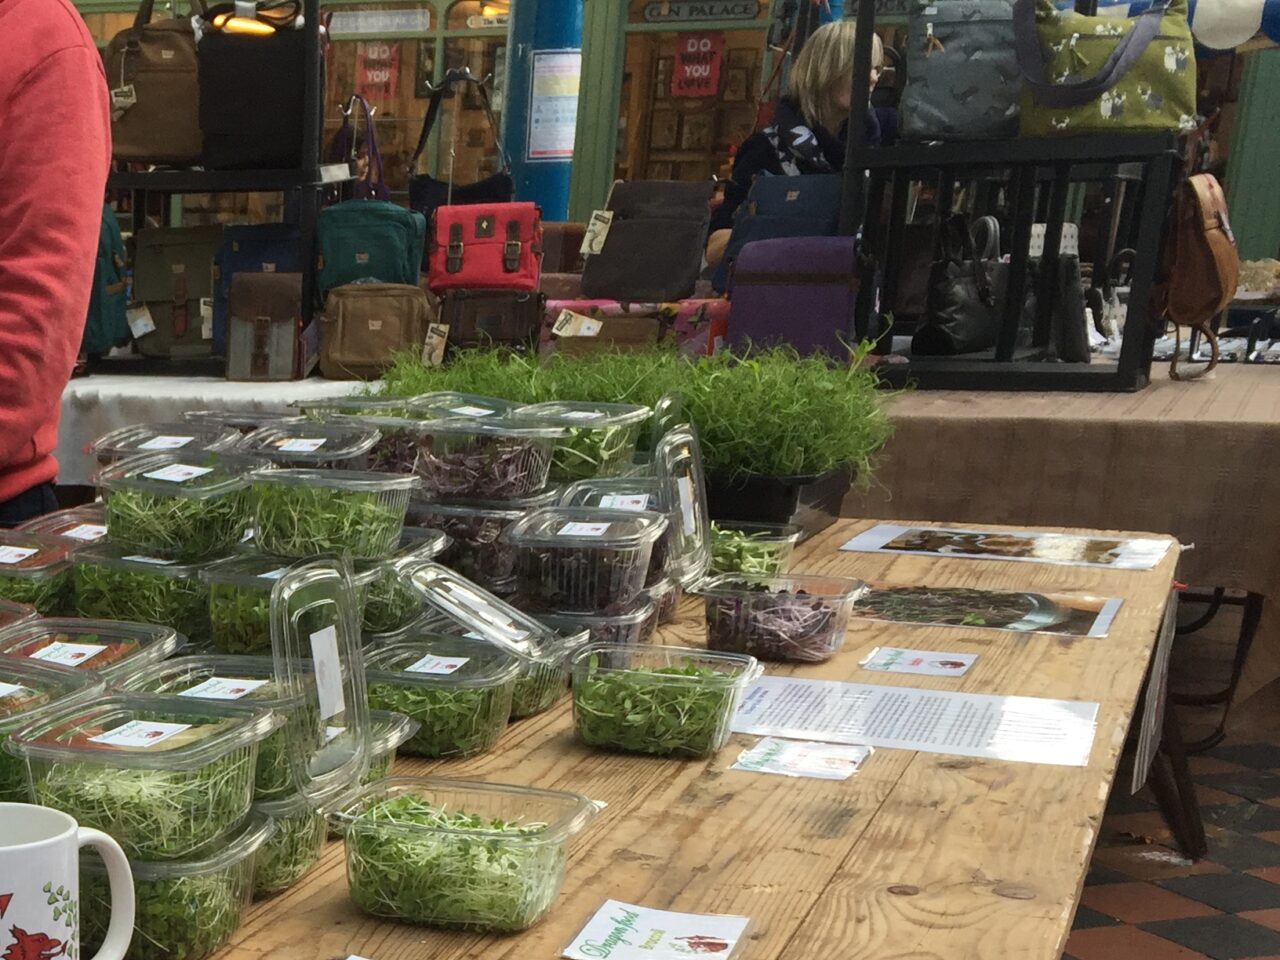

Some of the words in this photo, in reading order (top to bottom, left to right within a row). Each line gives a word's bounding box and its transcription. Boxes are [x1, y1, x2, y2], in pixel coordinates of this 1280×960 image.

[649, 6, 680, 18] GN
[688, 3, 753, 17] PALACE
[687, 39, 711, 52] DO
[685, 64, 710, 77] YOU
